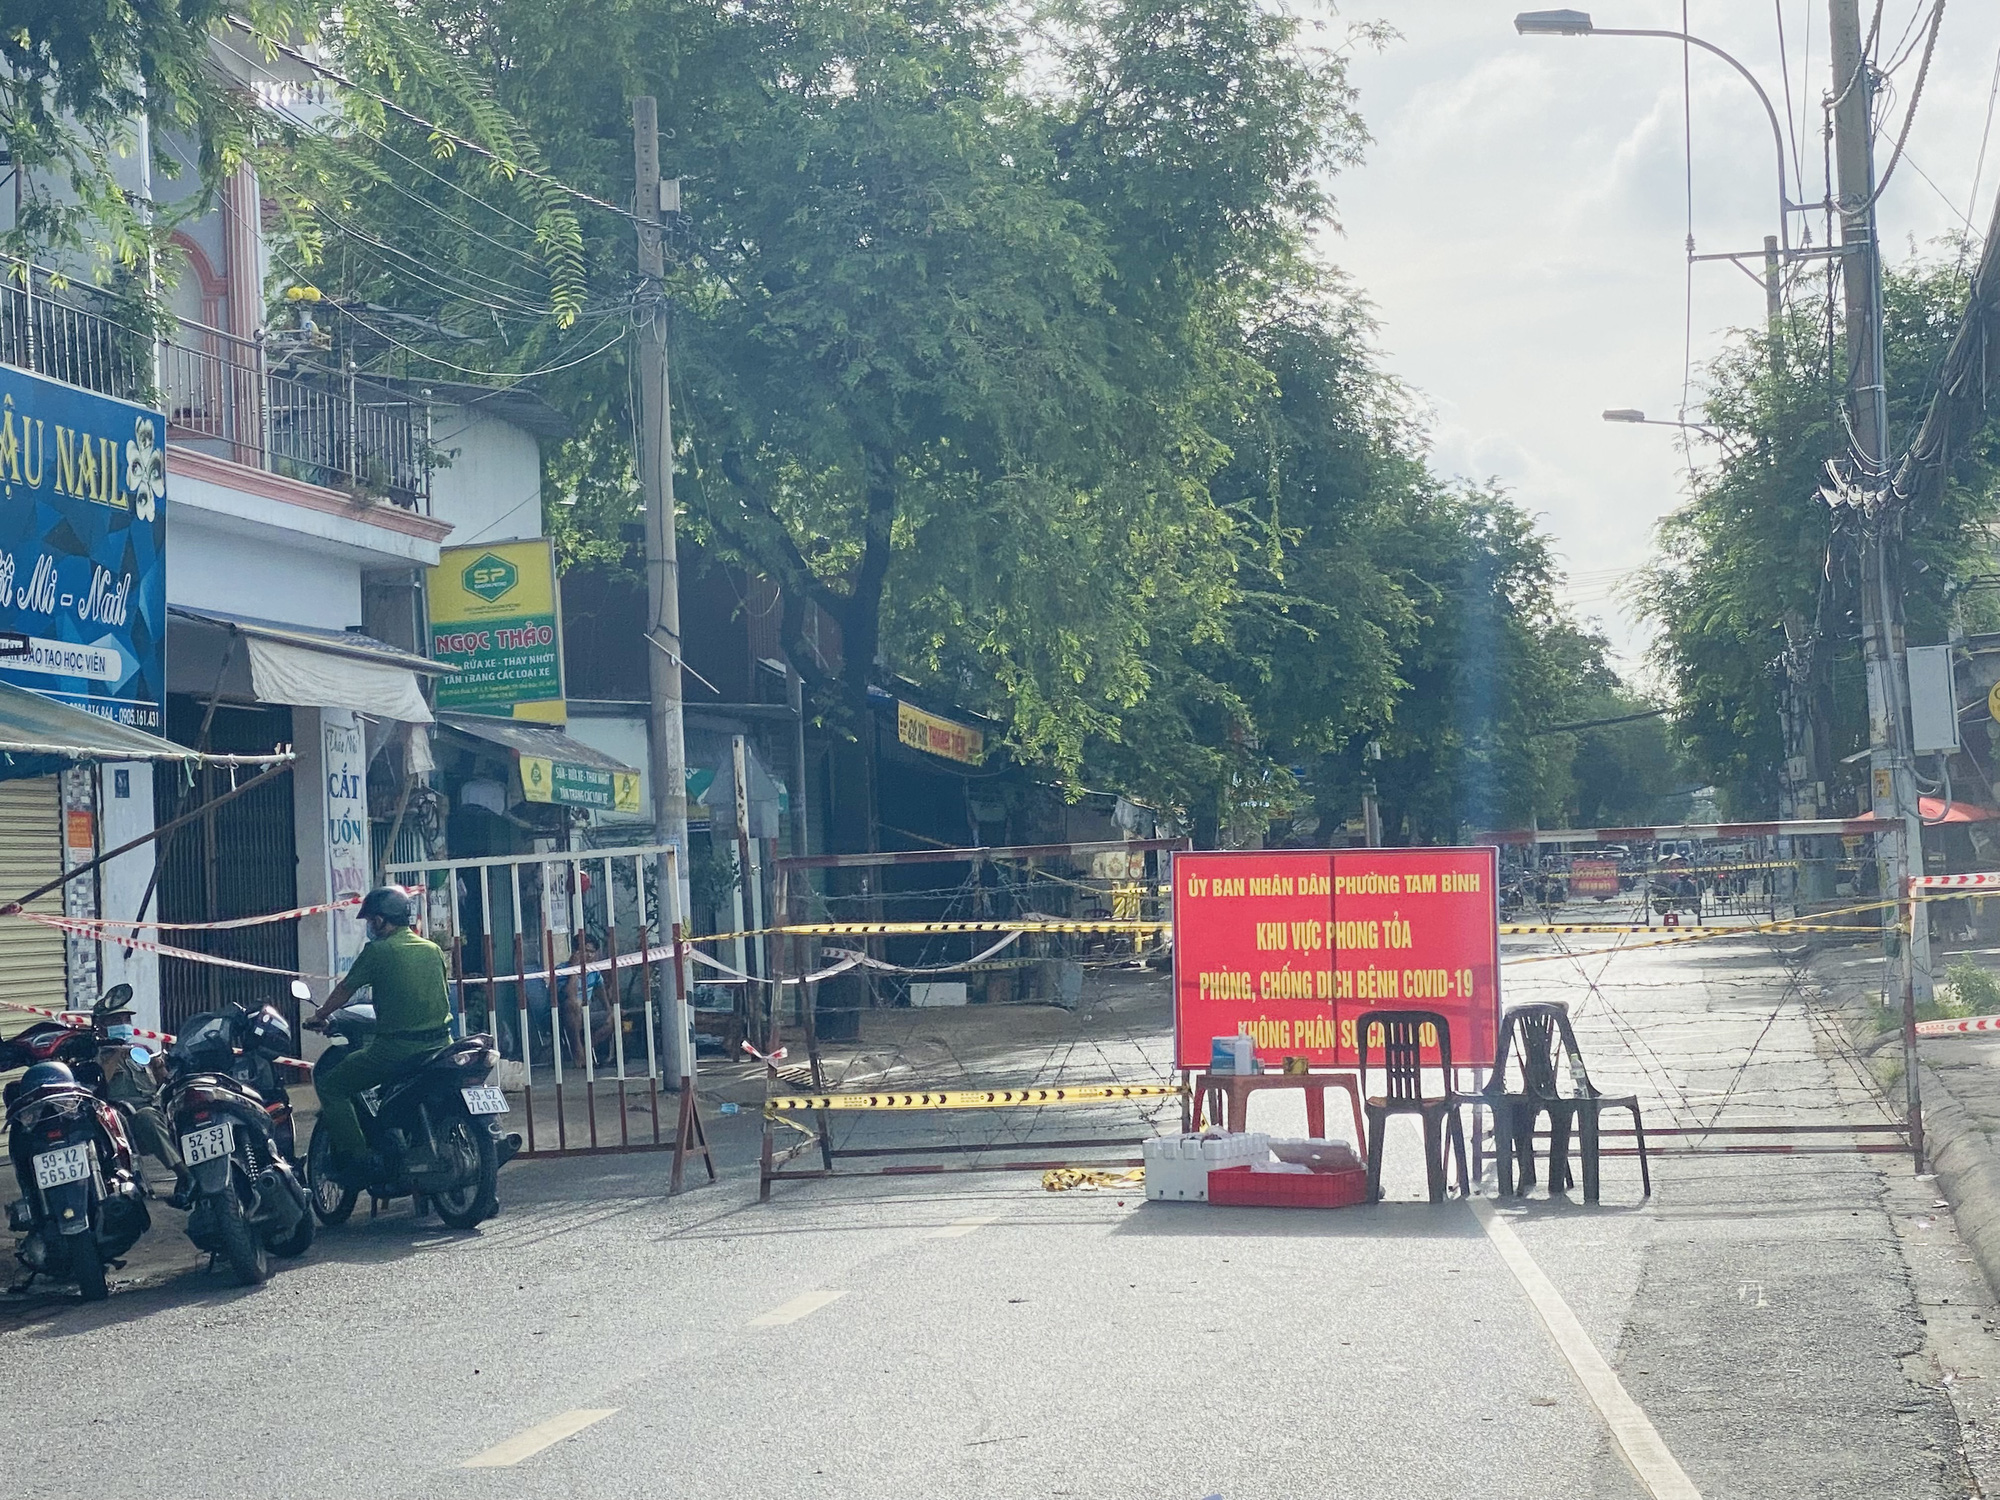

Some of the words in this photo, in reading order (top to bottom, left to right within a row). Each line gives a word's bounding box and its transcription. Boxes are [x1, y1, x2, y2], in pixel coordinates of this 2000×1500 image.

[54, 425, 128, 511] NAIL
[17, 553, 57, 615] Mi
[78, 564, 131, 627] Nail
[473, 567, 506, 584] SP
[435, 631, 491, 656] NGỌC
[494, 620, 553, 650] THẢO
[63, 651, 84, 673] HỌC
[85, 651, 106, 673] VIÊN
[485, 658, 496, 668] XE
[503, 655, 527, 668] THAY
[529, 652, 555, 665] NHỚT
[497, 667, 515, 680] CÁC
[516, 667, 537, 680] LOẠI
[539, 667, 550, 677] XE
[329, 762, 360, 800] CẮT
[330, 807, 361, 845] UỐN
[1188, 873, 1208, 897] ỦY
[1213, 878, 1245, 896] BAN
[1249, 874, 1293, 896] NHÂN
[1298, 873, 1331, 896] DÂN
[1335, 872, 1400, 895] PHƯỜNG
[1404, 874, 1437, 893] TAM
[1442, 870, 1480, 892] BÌNH
[1257, 922, 1287, 950] KHU
[1291, 919, 1321, 956] VỰC
[1326, 920, 1379, 950] PHONG
[1382, 911, 1412, 948] TỎA
[1199, 965, 1256, 1003] PHÒNG,
[1260, 960, 1312, 1000] CHỐNG
[1316, 970, 1353, 1005] DỊCH
[1357, 964, 1398, 1005] BỆNH
[1402, 969, 1474, 998] COVID-19
[1294, 1014, 1336, 1054] PHẬN
[467, 1089, 498, 1101] 59-G2
[39, 1163, 84, 1186] 565.67
[42, 1149, 79, 1169] 59-X2
